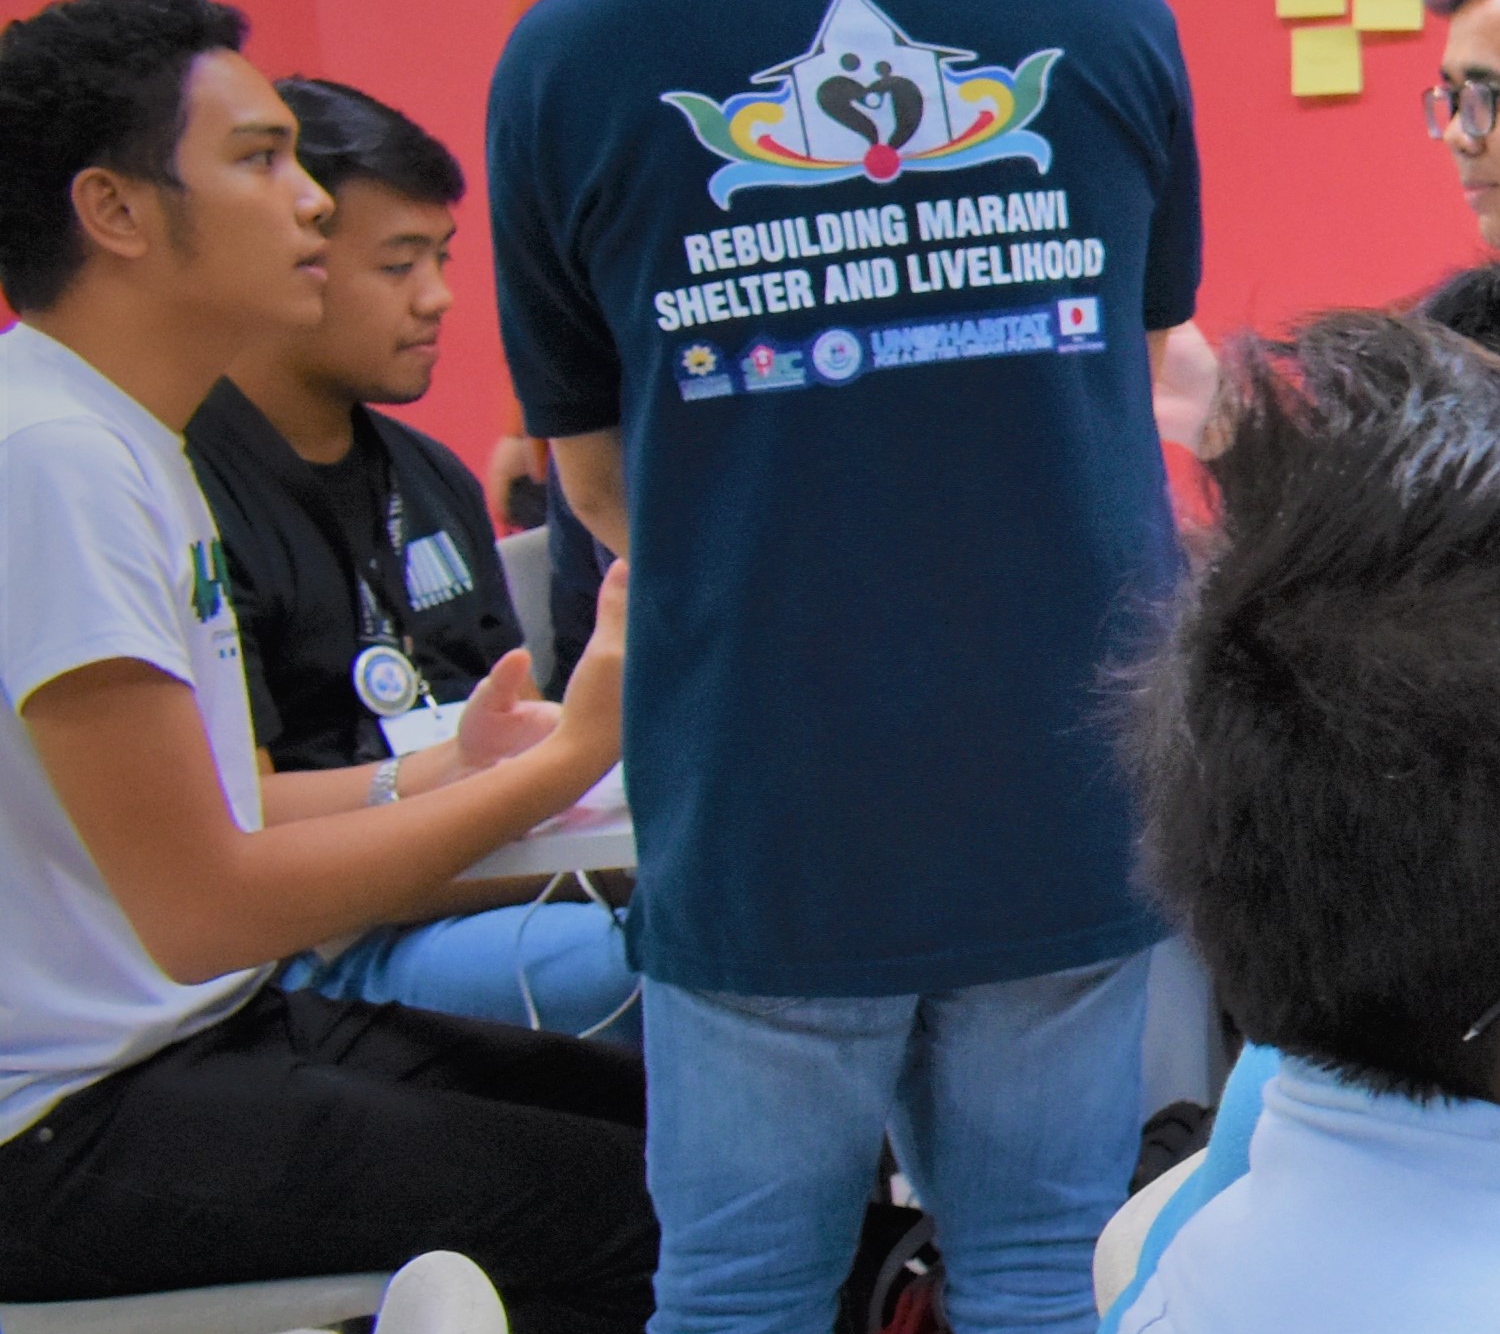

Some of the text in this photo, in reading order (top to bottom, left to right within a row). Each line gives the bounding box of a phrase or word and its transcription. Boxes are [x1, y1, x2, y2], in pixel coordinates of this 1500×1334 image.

[685, 189, 1069, 275] REBUILDING MARAWI
[654, 237, 1105, 333] SHELTER AND LIVELIHOOD
